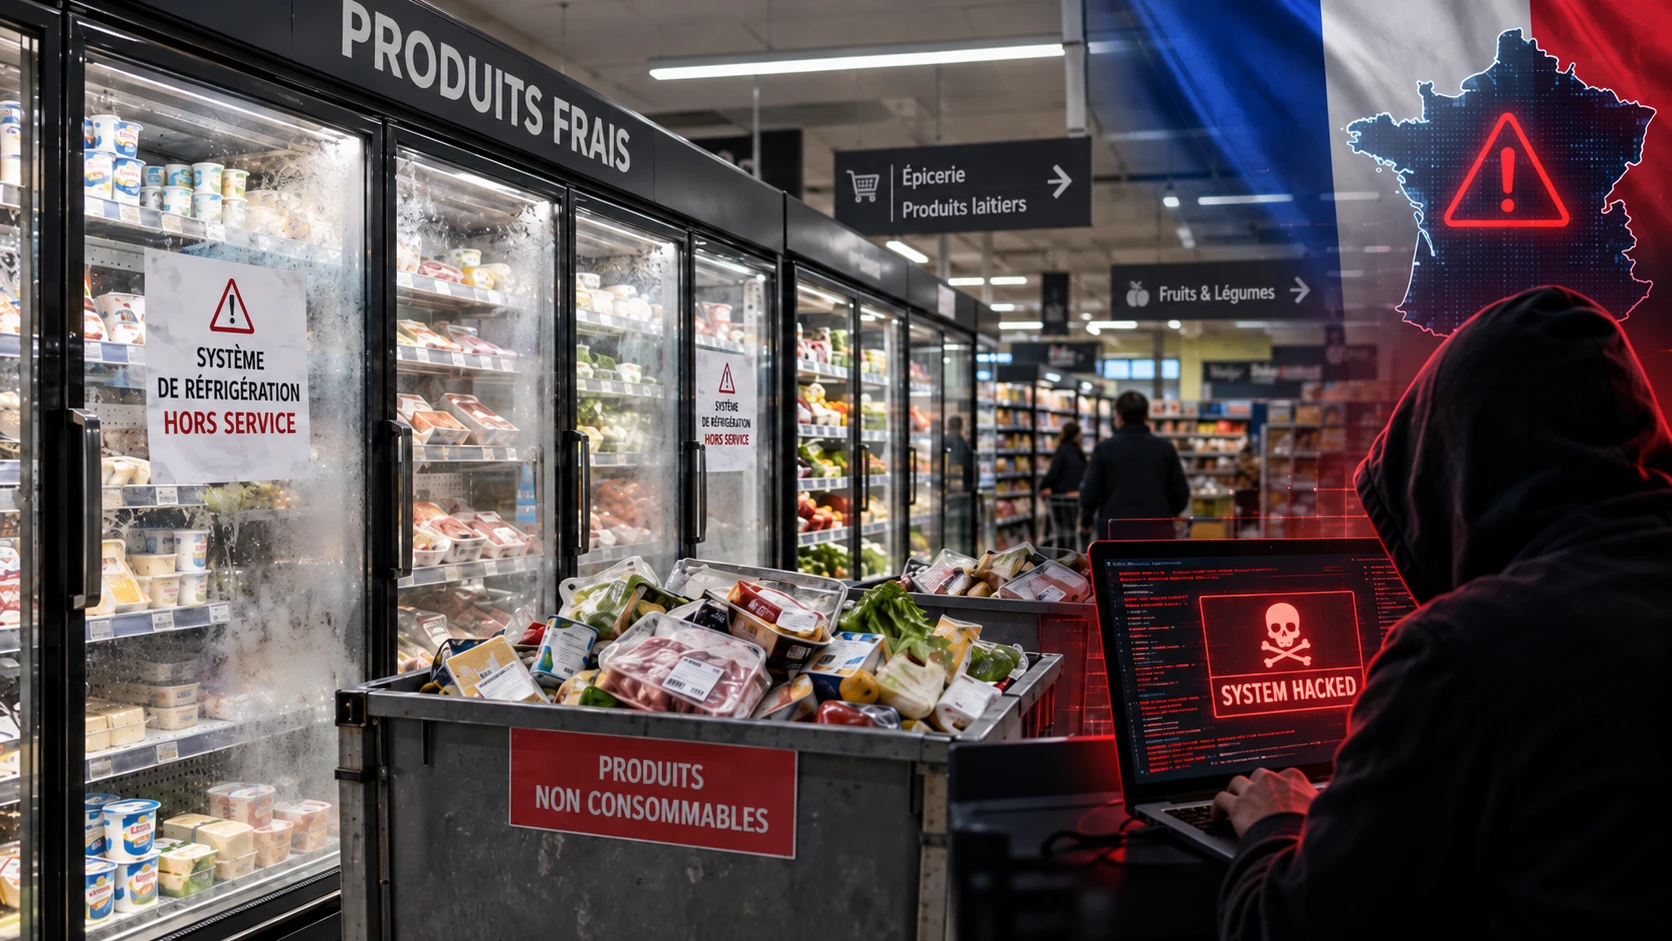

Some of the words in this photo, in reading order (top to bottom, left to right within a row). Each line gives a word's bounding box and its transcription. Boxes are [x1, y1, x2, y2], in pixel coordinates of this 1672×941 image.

[342, 0, 544, 136] PRODUITS
[553, 96, 631, 173] FRAIS
[902, 164, 966, 190] Épicerie
[903, 199, 968, 219] Produits
[972, 196, 1027, 215] laitiers
[1159, 285, 1197, 302] Fruits
[1200, 285, 1211, 301] &
[1214, 284, 1276, 304] Légumes
[197, 344, 265, 371] SYSTÈME
[158, 377, 179, 399] DE
[185, 374, 300, 402] RÉFRIGÉRATION
[164, 411, 217, 434] HORS
[224, 411, 297, 434] SERVICE
[702, 416, 709, 427] DE
[704, 434, 723, 445] HORS
[724, 434, 749, 445] SERVICE
[1221, 680, 1288, 706] SYSTEM
[1292, 676, 1357, 700] HACKED
[599, 755, 704, 790] PRODUITS
[535, 784, 580, 813] NON
[587, 790, 769, 834] CONSOMMABLES
